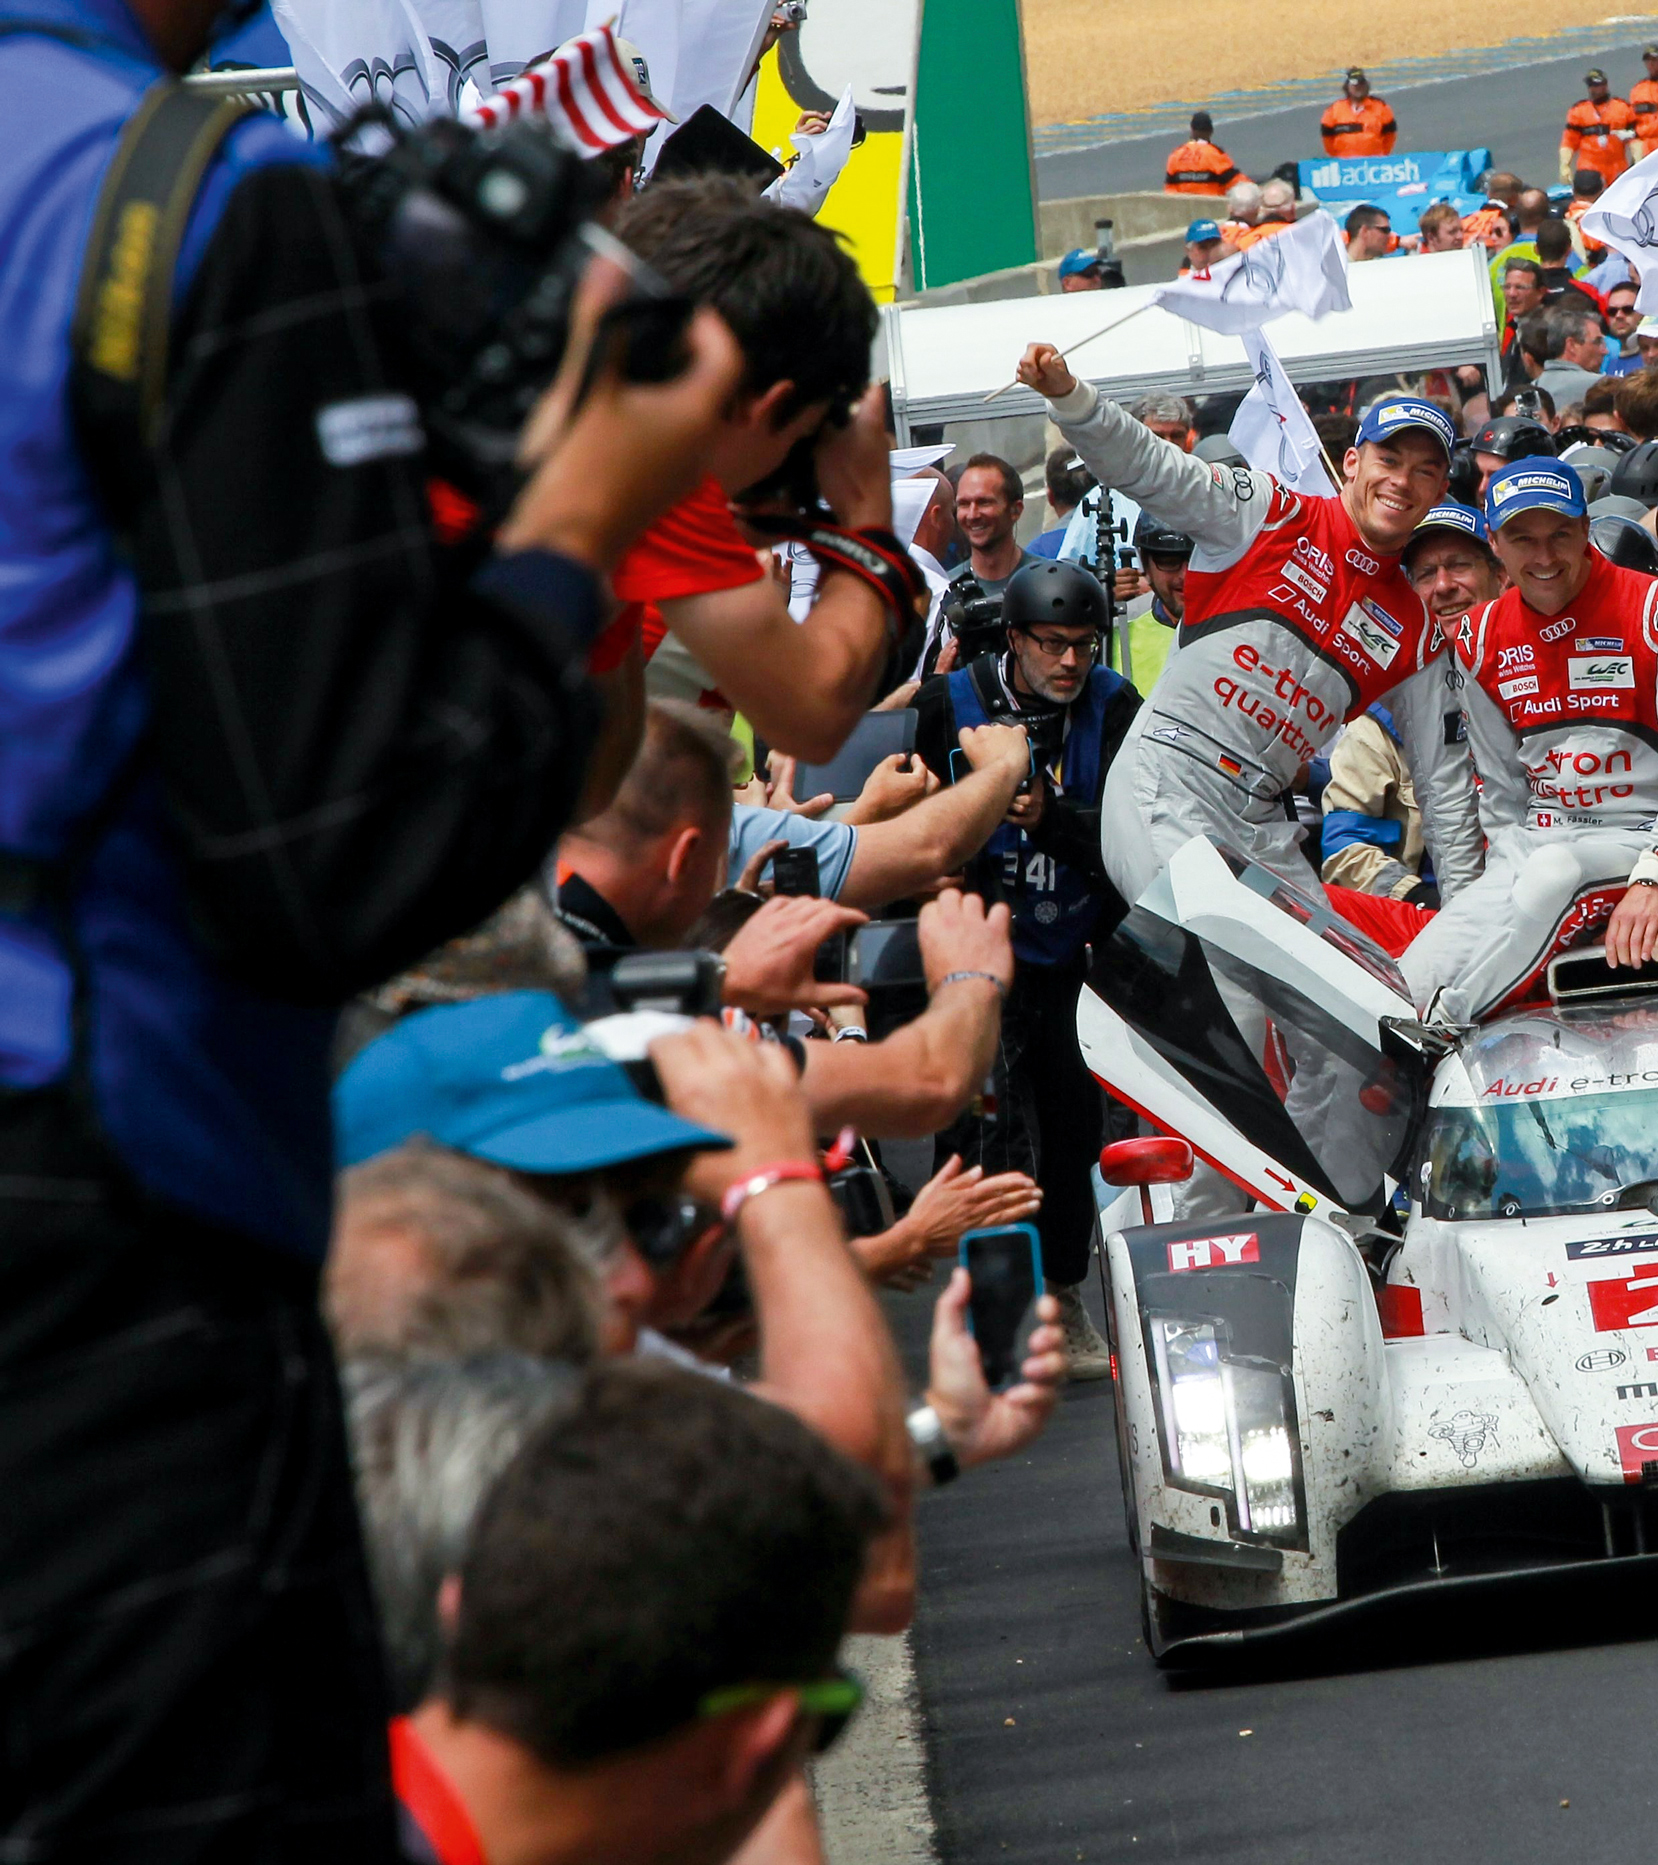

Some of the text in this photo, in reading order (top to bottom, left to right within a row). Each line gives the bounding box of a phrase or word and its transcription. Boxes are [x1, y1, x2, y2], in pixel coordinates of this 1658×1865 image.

[1341, 158, 1420, 186] adcash
[1409, 406, 1452, 438] MICHELIN
[1517, 475, 1568, 490] MICHELIN
[1297, 536, 1335, 576] ORIS
[1297, 573, 1324, 600] BOSCH
[1294, 598, 1371, 675] Audi Sport
[1512, 681, 1538, 693] BOSCH
[1524, 693, 1620, 715] Audi Sport
[1213, 676, 1316, 763] quattro
[1521, 749, 1632, 776] -tron
[1567, 814, 1603, 825] Fässler
[1483, 1075, 1557, 1097] Audi
[1170, 1234, 1252, 1270] HY
